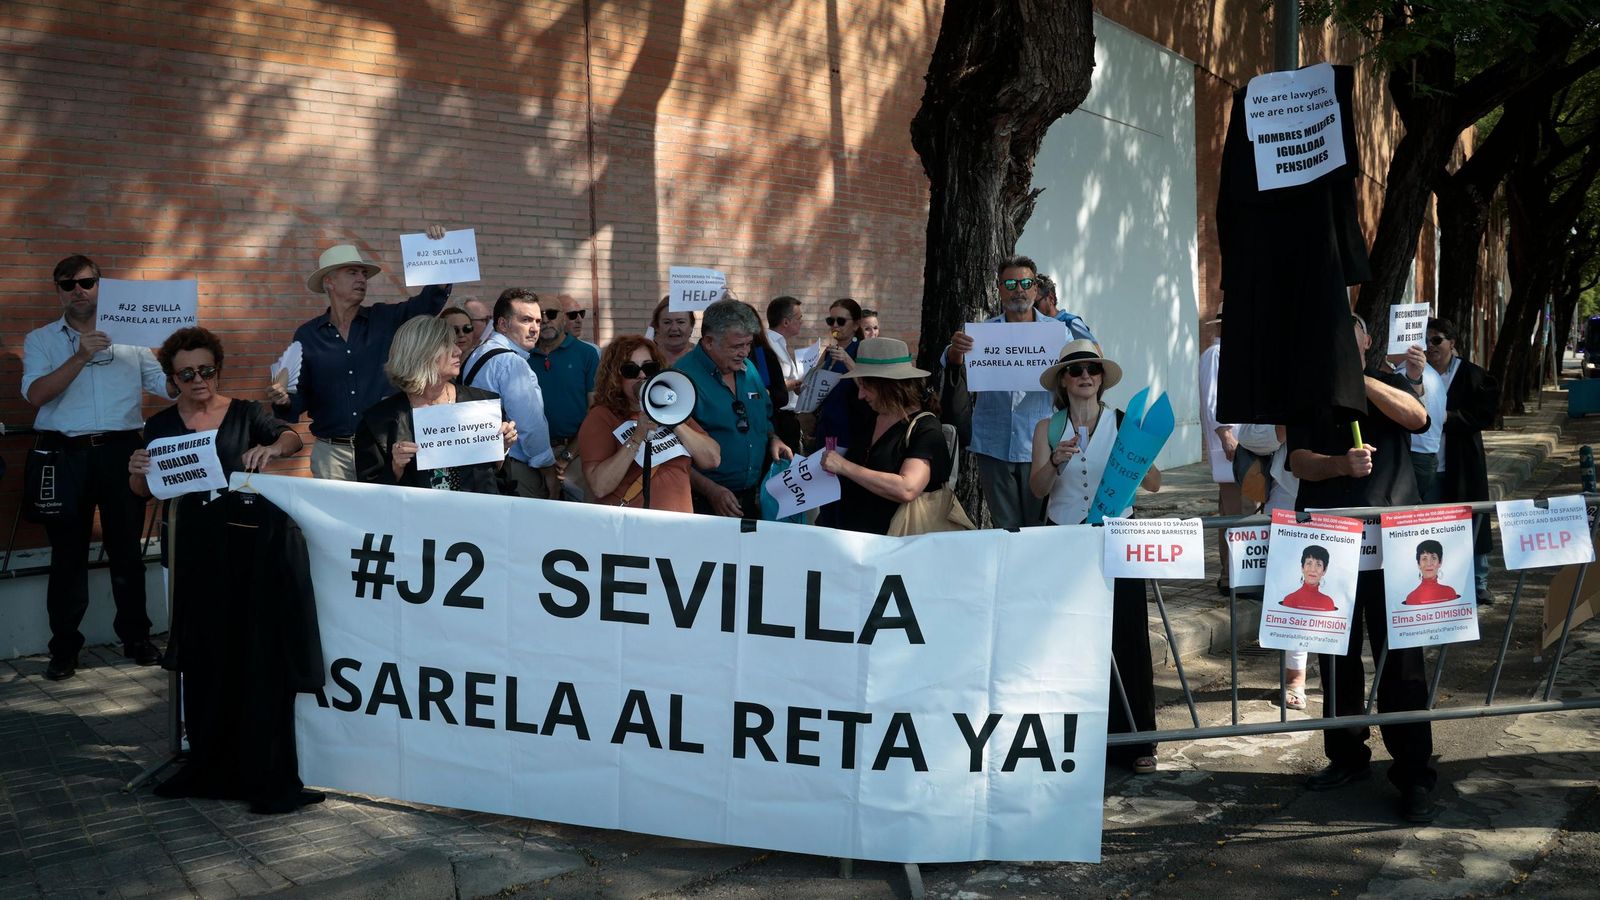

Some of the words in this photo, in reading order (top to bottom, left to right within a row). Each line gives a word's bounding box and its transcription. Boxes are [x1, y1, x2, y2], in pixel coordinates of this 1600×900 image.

[1253, 96, 1268, 104] We
[1271, 94, 1288, 102] are
[1291, 86, 1328, 99] lawyers,
[1267, 109, 1284, 117] are
[1287, 105, 1304, 114] not
[1307, 98, 1334, 111] slaves
[1258, 129, 1302, 144] HOMBRES
[1277, 136, 1325, 157] IGUALDAD
[1276, 150, 1328, 174] PENSIONES
[432, 248, 462, 256] SEVILLA
[682, 290, 717, 301] HELP
[118, 303, 136, 311] #J2
[142, 304, 181, 312] SEVILLA
[100, 314, 147, 324] ¡PASARELA
[1397, 334, 1404, 342] NO
[1005, 346, 1046, 354] SEVILLA
[969, 360, 1012, 368] ¡PASARELA
[422, 427, 438, 435] We
[440, 426, 455, 434] are
[177, 437, 211, 452] MUJERES
[437, 439, 452, 447] are
[455, 437, 470, 445] not
[473, 434, 500, 443] slaves
[157, 453, 199, 471] IGUALDAD
[162, 468, 207, 486] PENSIONES
[783, 469, 806, 506] ALISM
[1228, 531, 1257, 542] ZONA
[1261, 530, 1270, 540] D
[1278, 529, 1308, 539] Ministra
[1310, 532, 1319, 540] de
[1321, 533, 1355, 544] Exclusión
[1389, 529, 1418, 538] Ministra
[1431, 524, 1465, 534] Exclusión
[1520, 530, 1571, 552] HELP
[1126, 544, 1183, 562] HELP
[1246, 545, 1269, 556] CON
[350, 533, 485, 610] #J2
[538, 549, 926, 646] SEVILLA
[1266, 615, 1287, 624] Elma
[1289, 617, 1307, 626] Saiz
[1309, 619, 1346, 630] DIMISIÓN
[1392, 616, 1414, 624] Elma
[1416, 613, 1433, 621] Saiz
[1435, 606, 1472, 619] DIMISIÓN
[312, 658, 590, 741] SARELA
[611, 690, 704, 754] AL
[732, 701, 928, 772] RETA
[953, 713, 1078, 772] YA!
